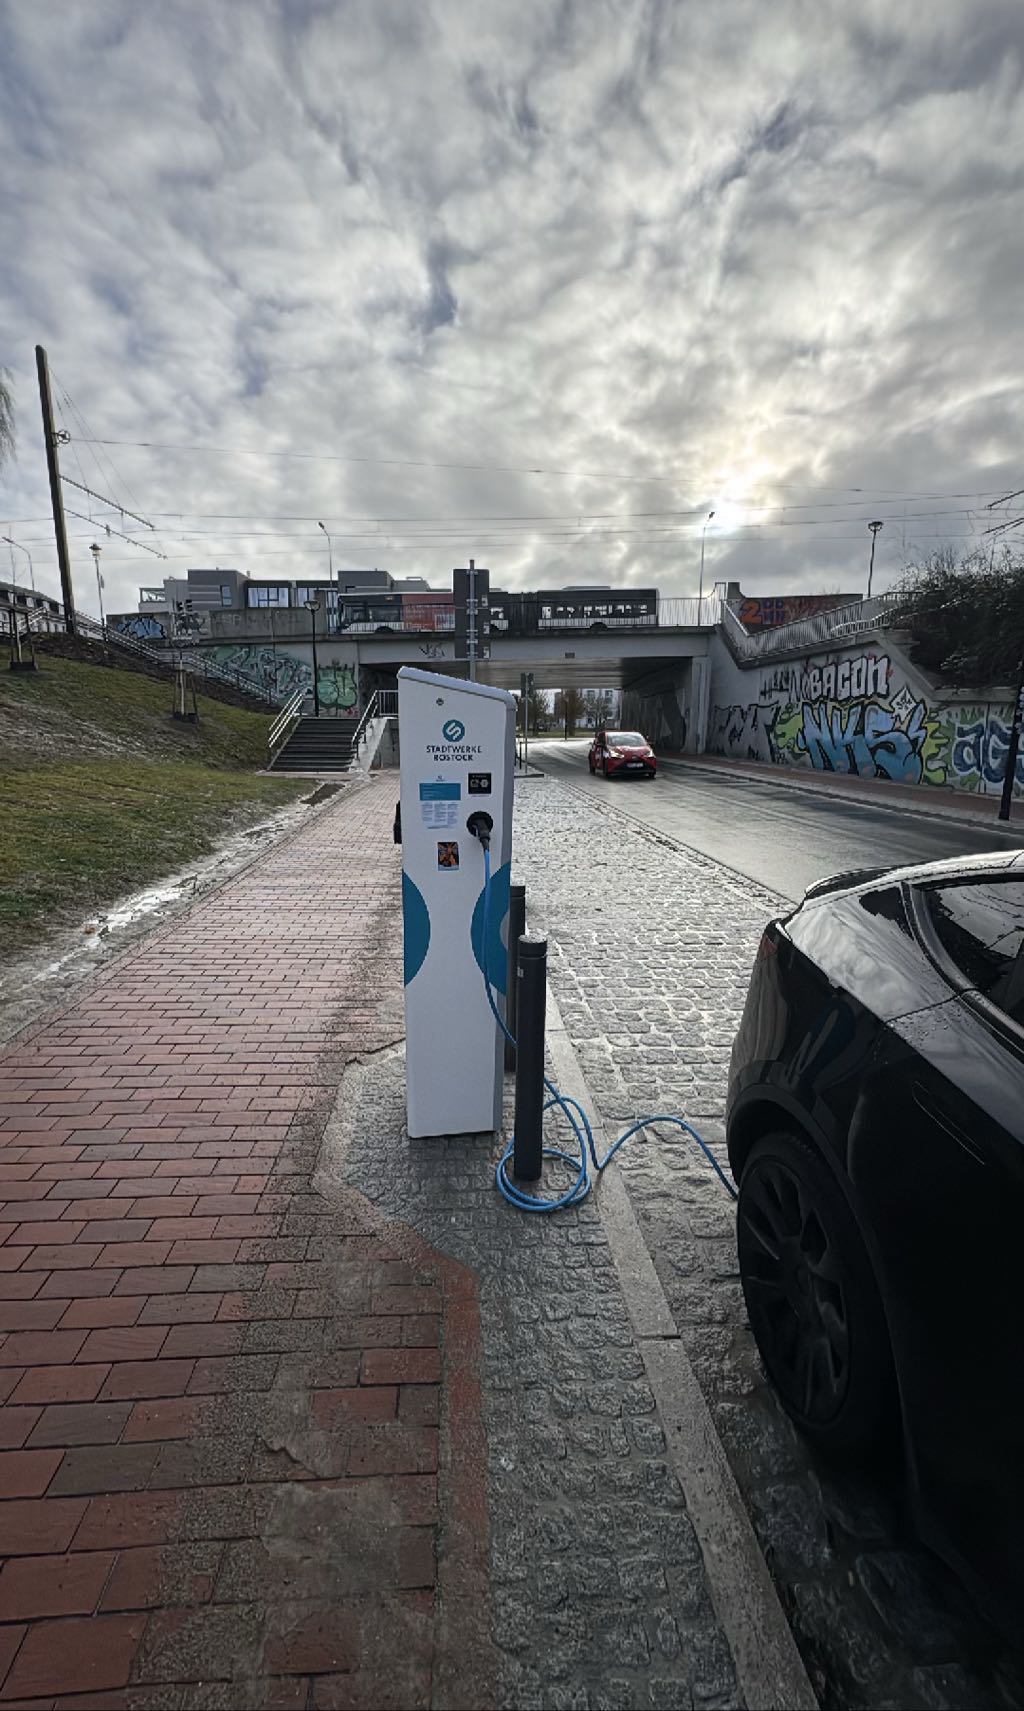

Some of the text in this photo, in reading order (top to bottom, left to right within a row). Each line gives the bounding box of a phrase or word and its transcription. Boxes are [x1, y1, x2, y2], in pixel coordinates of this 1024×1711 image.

[810, 655, 891, 702] BACON
[426, 745, 482, 753] STADTWERKE
[433, 754, 474, 762] ROSTOCK
